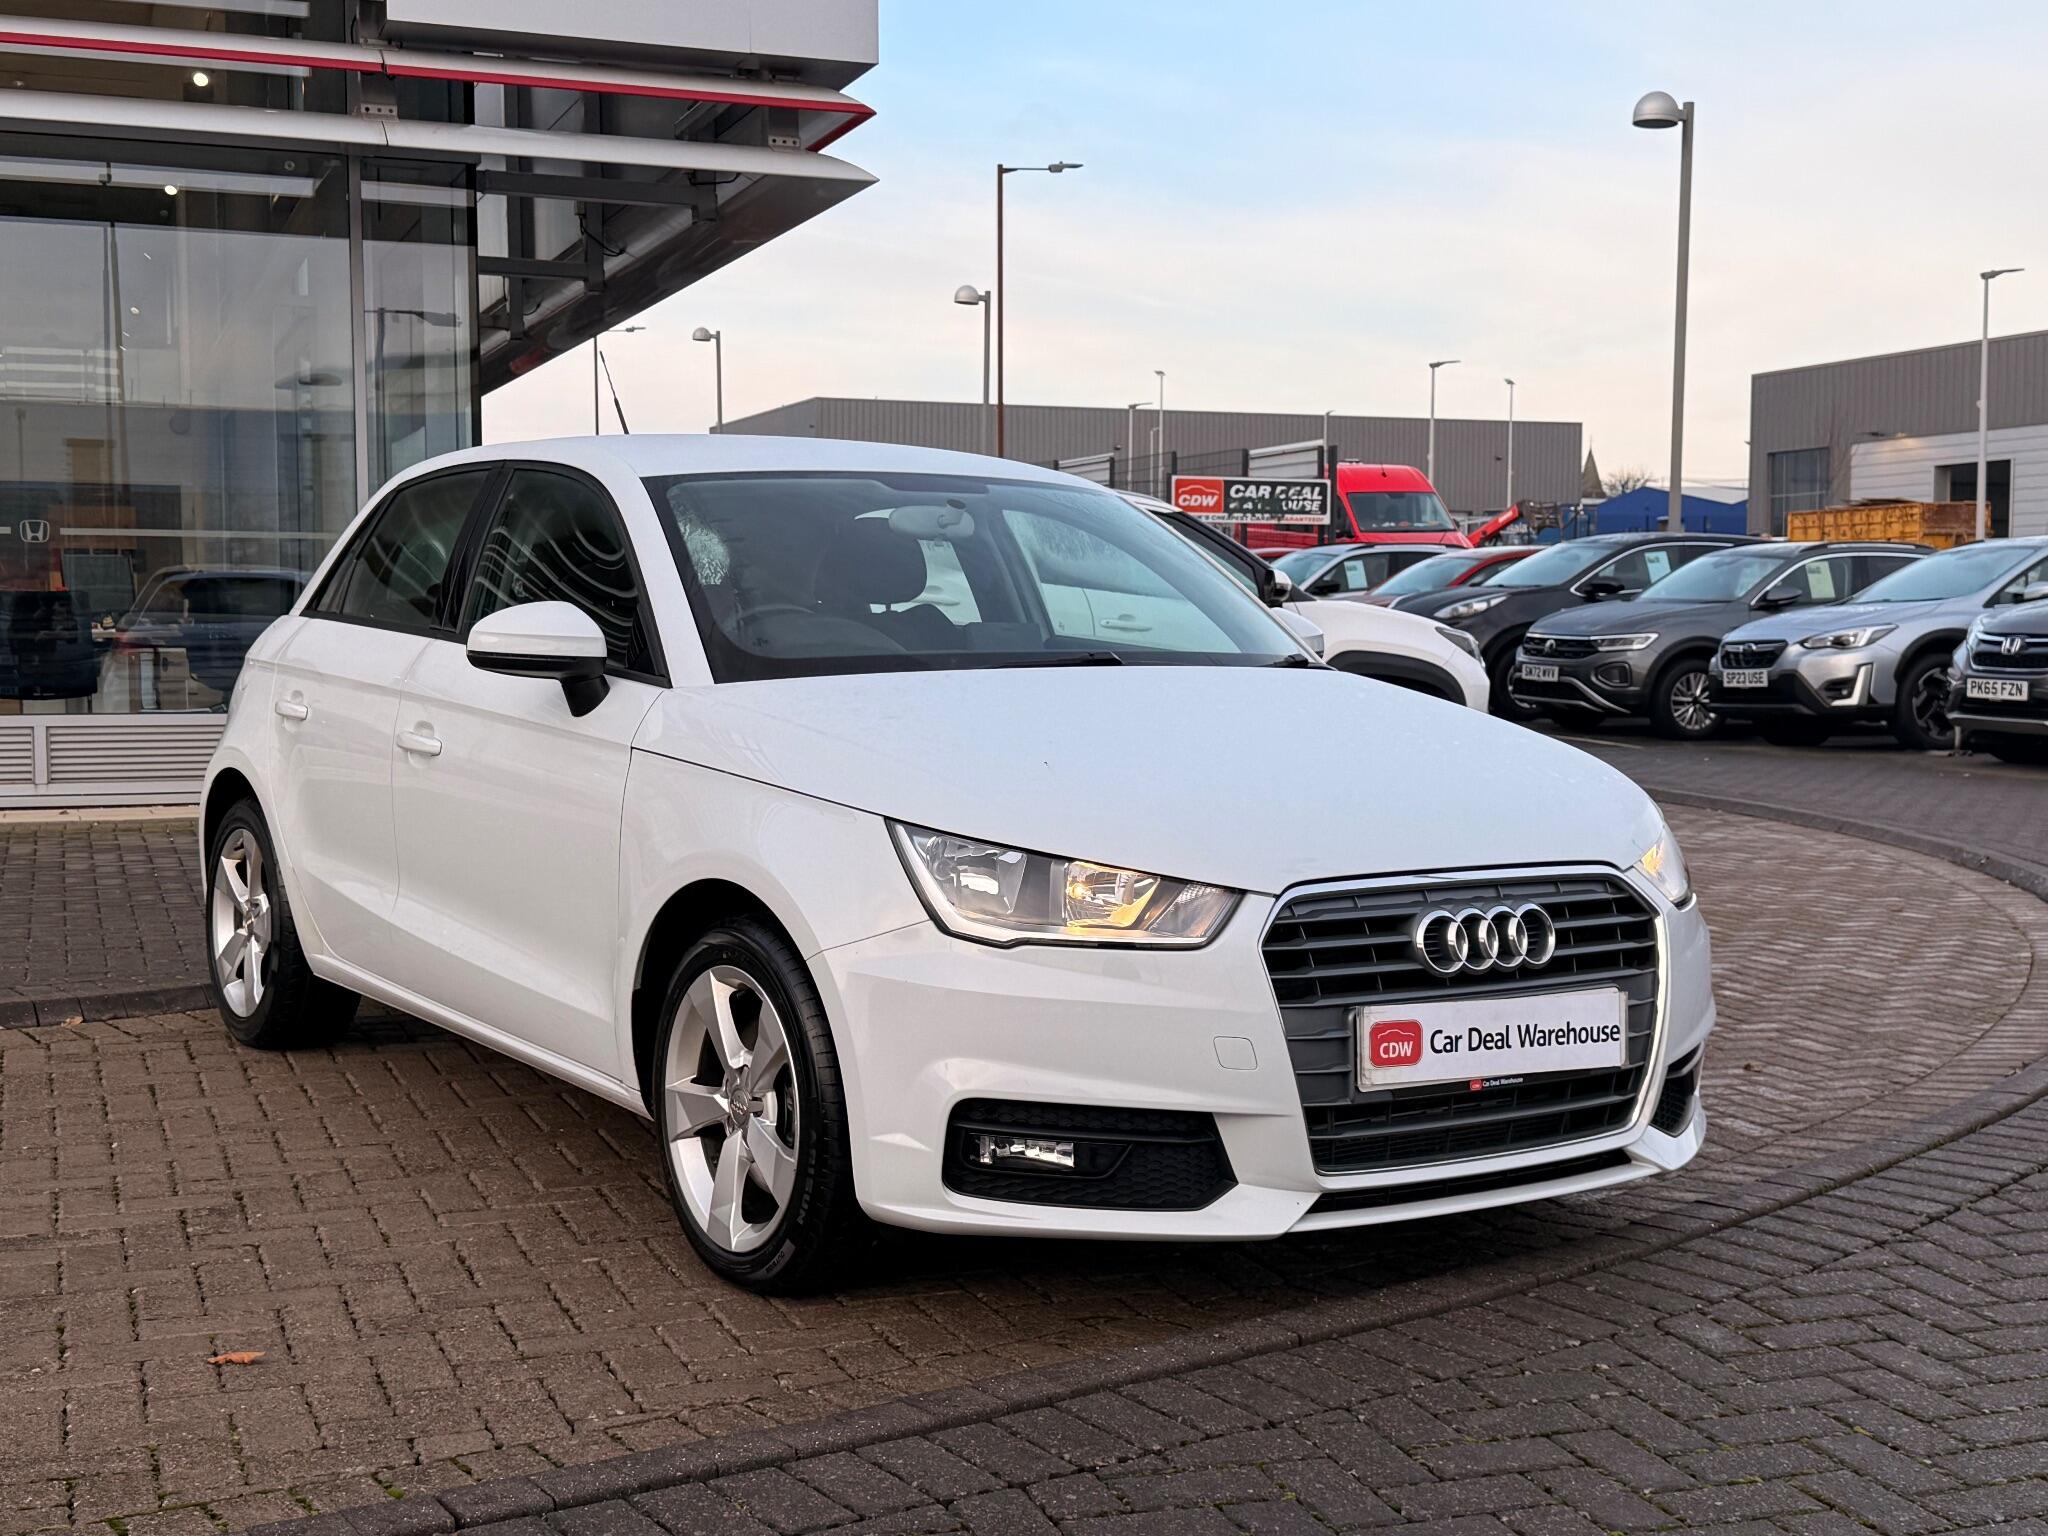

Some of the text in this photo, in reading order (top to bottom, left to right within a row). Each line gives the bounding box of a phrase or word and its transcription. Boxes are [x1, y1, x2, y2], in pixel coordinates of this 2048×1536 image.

[1229, 484, 1323, 500] CAR DEAL
[1178, 494, 1219, 507] CDW
[1726, 671, 1764, 685] SP23 USE
[1970, 680, 2022, 697] PK65 FZN
[1429, 1021, 1620, 1054] Car Deal Warehouse
[1379, 1040, 1414, 1059] CDW
